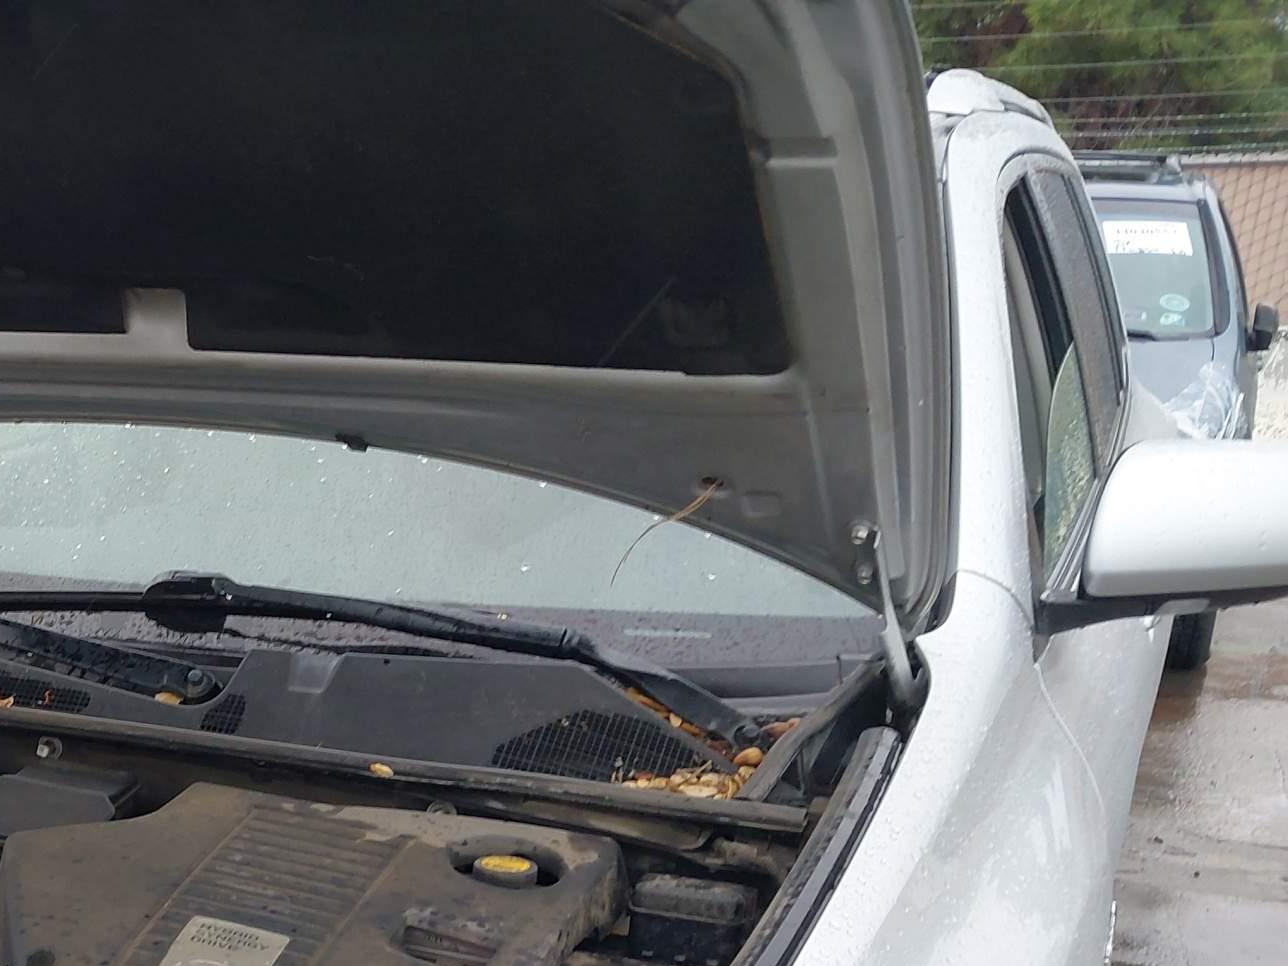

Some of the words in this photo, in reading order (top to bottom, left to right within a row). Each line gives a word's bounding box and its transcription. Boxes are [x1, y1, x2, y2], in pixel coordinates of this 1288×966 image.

[195, 928, 269, 951] SYNERGY
[199, 922, 260, 941] HYBRID
[191, 934, 238, 950] DRIVE
